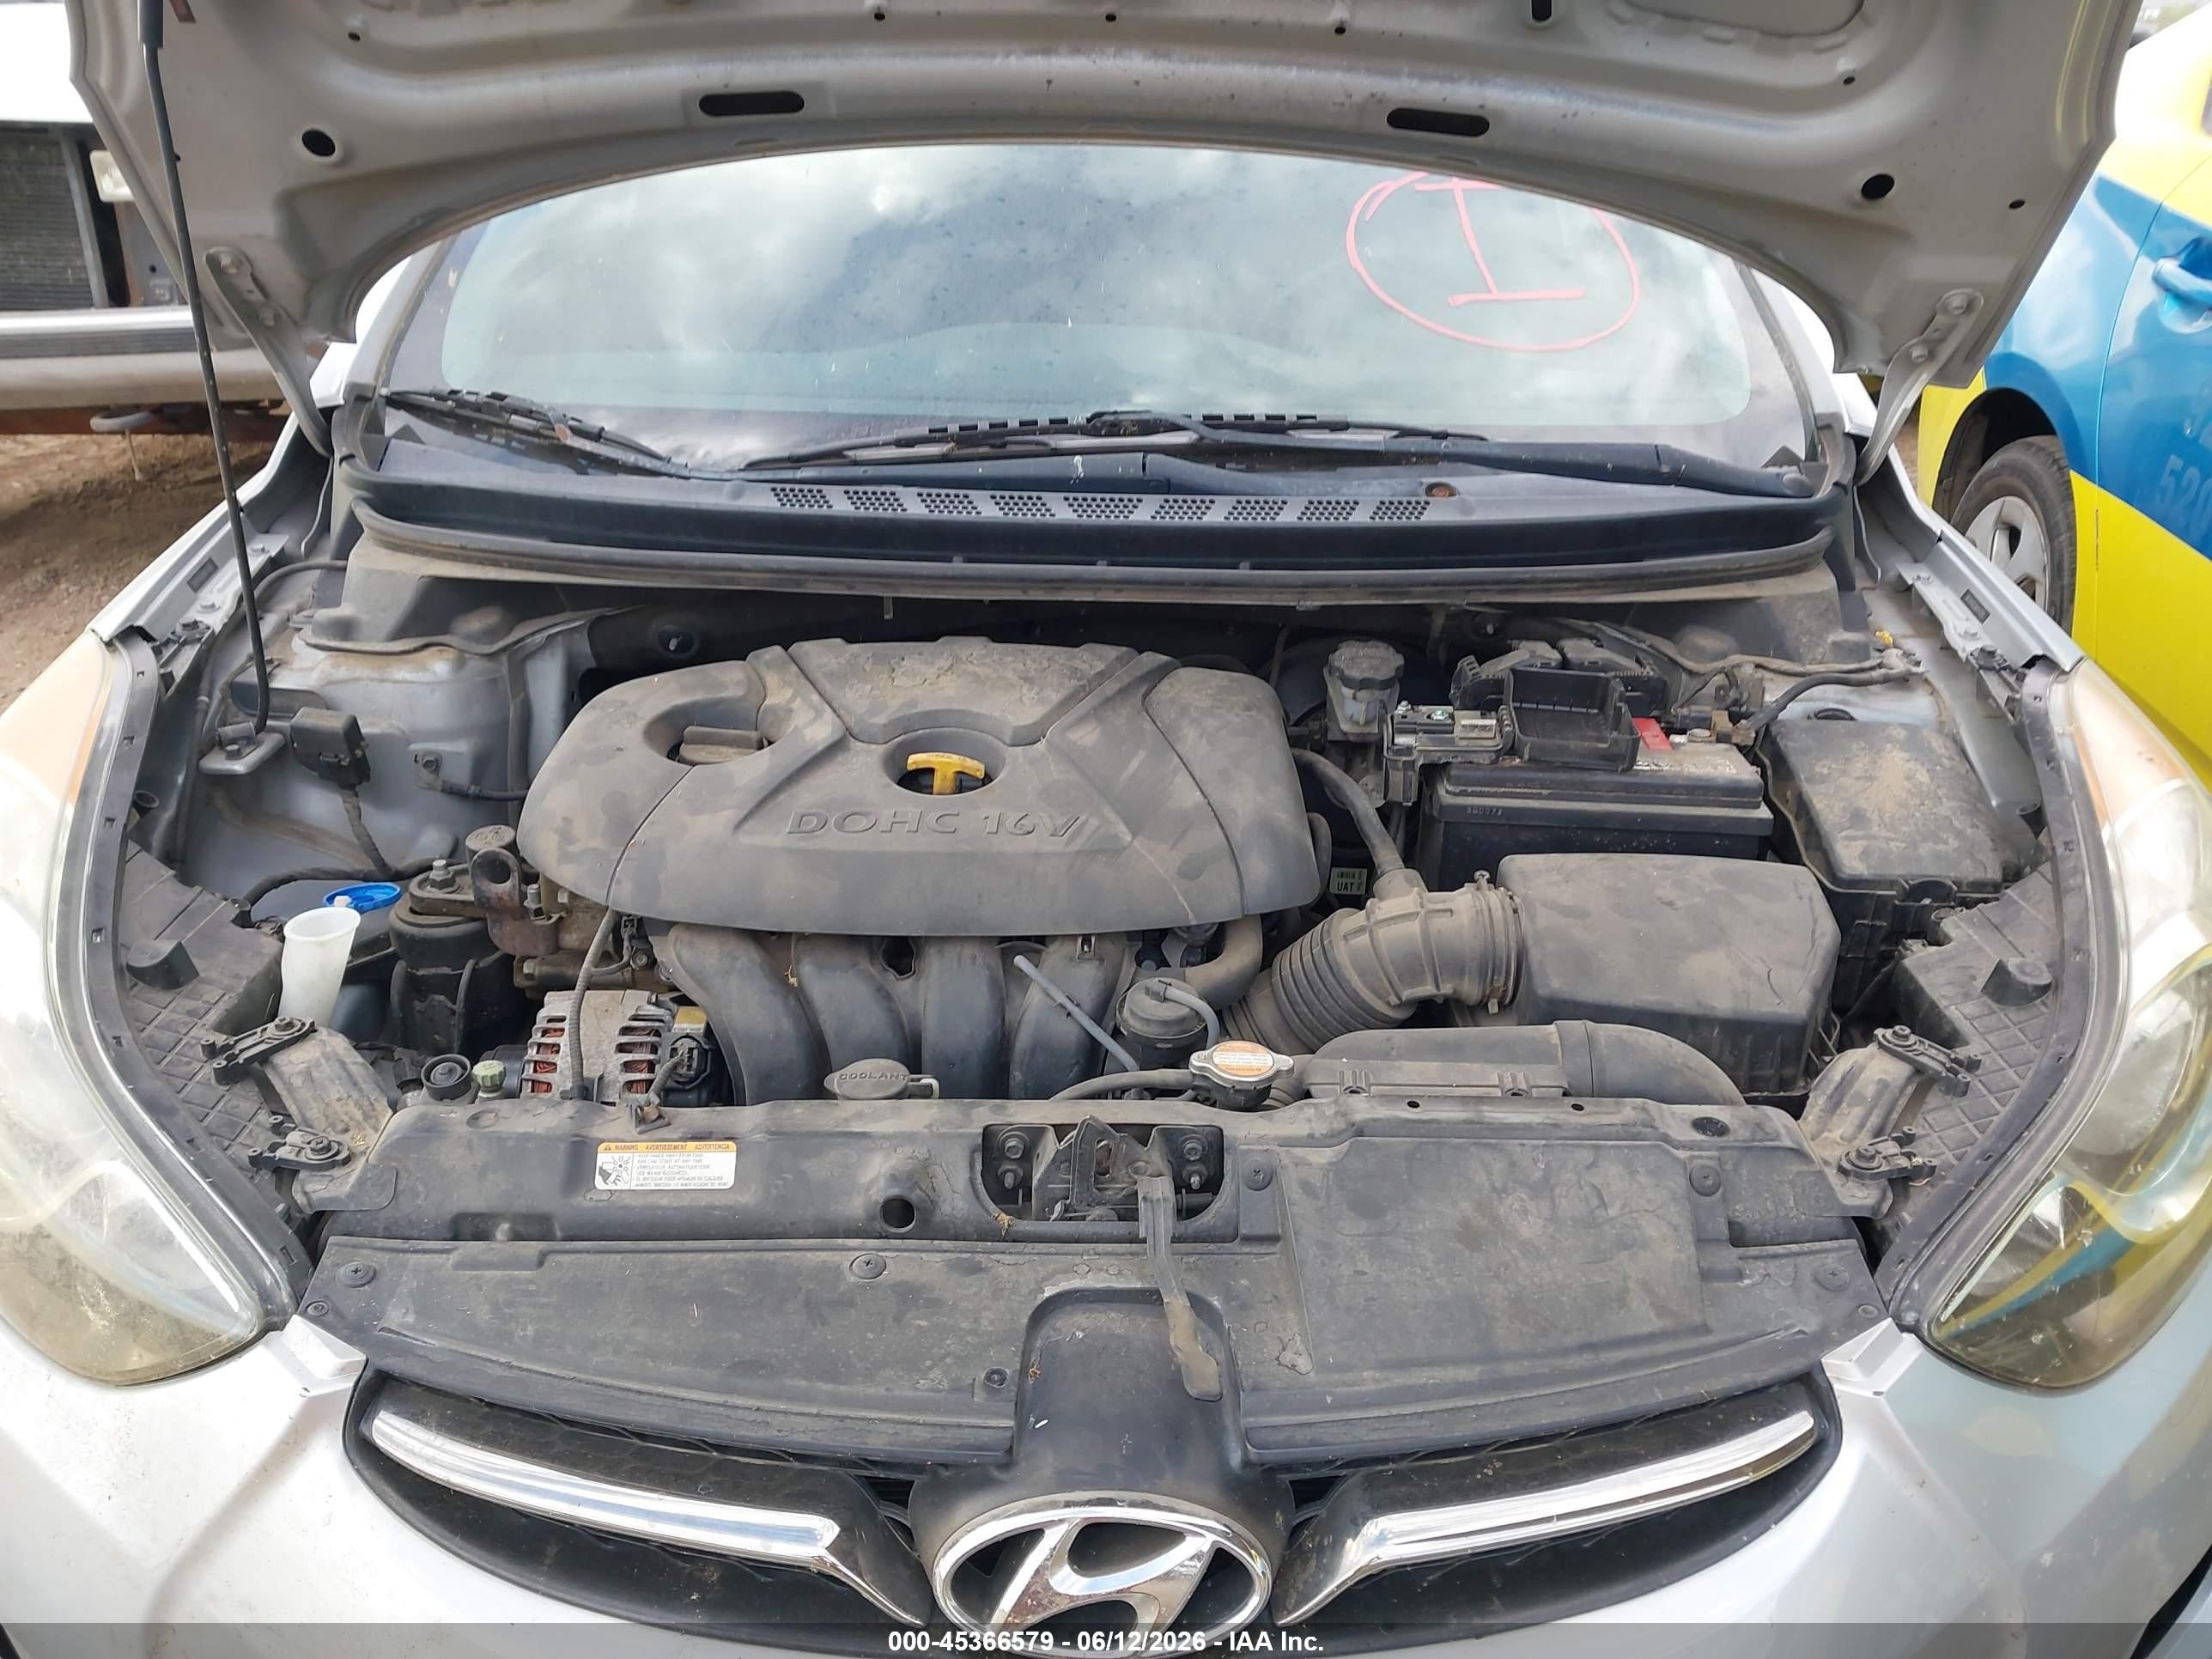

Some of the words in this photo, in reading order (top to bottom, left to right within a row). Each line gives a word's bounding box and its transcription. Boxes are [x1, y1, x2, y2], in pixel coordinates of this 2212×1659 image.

[786, 810, 960, 836] DOHC
[981, 811, 1087, 838] 16V
[1337, 881, 1354, 892] UAT
[839, 1072, 910, 1082] COOLANT
